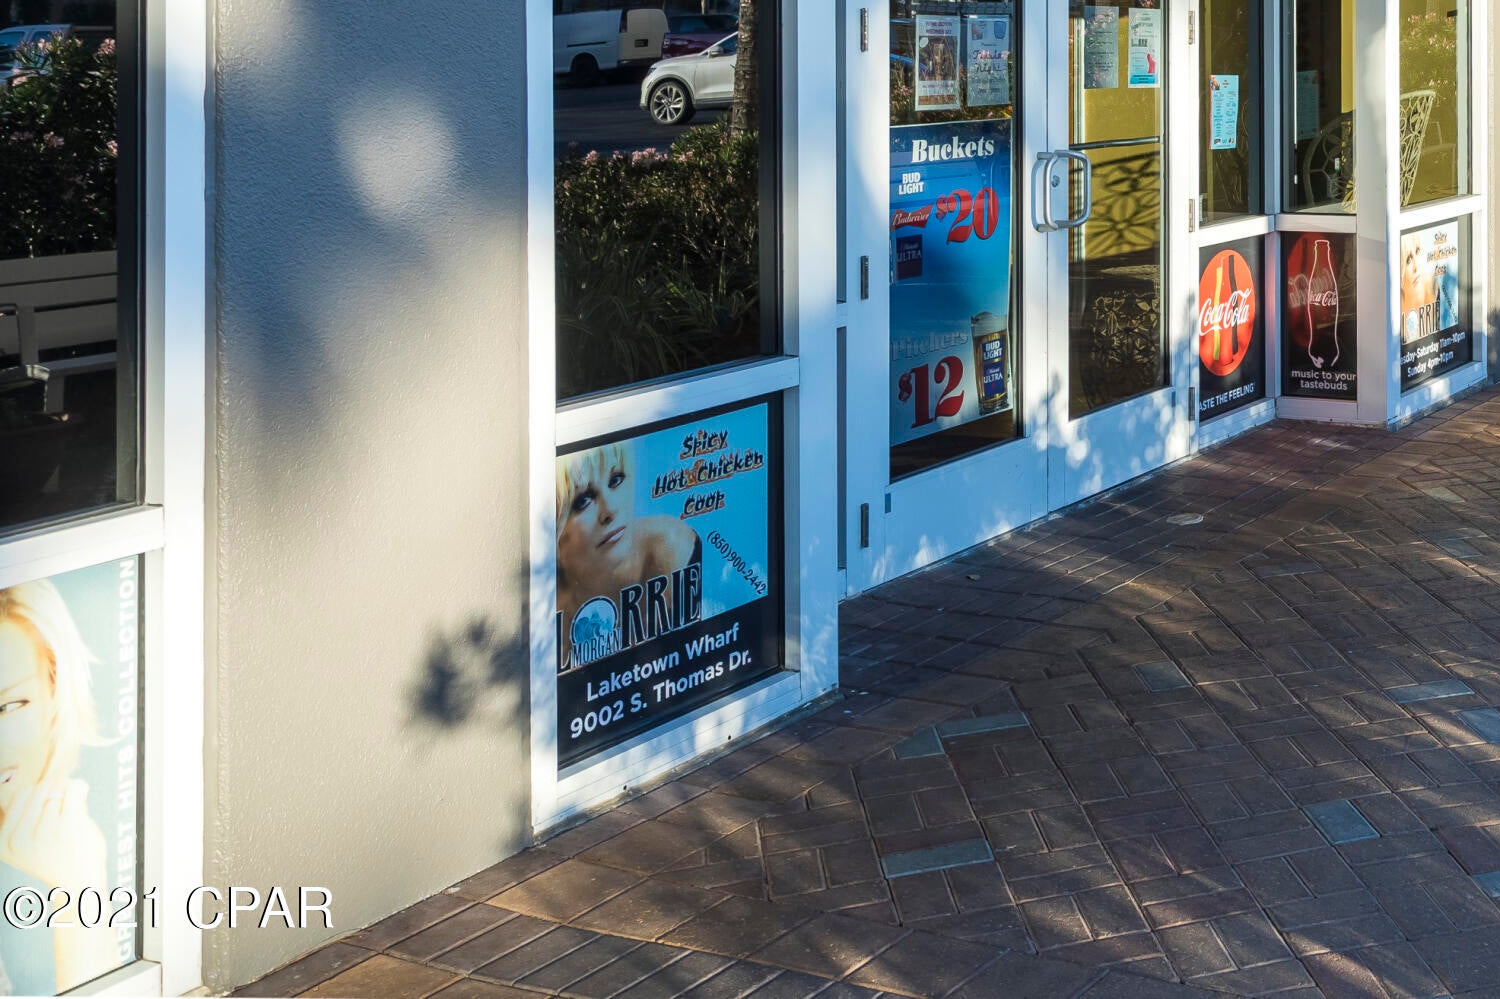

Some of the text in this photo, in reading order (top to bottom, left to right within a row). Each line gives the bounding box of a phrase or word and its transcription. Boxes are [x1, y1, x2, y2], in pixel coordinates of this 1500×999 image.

[911, 136, 995, 163] Buckets
[898, 181, 924, 194] LIGHT
[902, 172, 920, 183] BUD
[892, 212, 930, 226] Budweiser
[936, 186, 999, 245] $20
[983, 347, 1003, 360] LIGHT
[985, 340, 1001, 352] BUD
[983, 372, 1003, 384] ULTRA
[1291, 369, 1356, 382] music to your
[1407, 362, 1427, 378] Sunday
[898, 355, 964, 429] $12
[1216, 392, 1228, 406] THE
[1229, 382, 1254, 401] FEELING
[1301, 380, 1347, 391] tastebuds
[682, 429, 728, 457] Spicy
[653, 450, 764, 496] Hot Chicken
[683, 489, 725, 516] Coop
[706, 530, 767, 595] (850)900-2442
[118, 558, 136, 737] COLLECTION
[571, 627, 622, 669] MORGAN
[586, 622, 739, 702] Laketown Wharf
[570, 649, 752, 738] 9002 S. Thomas Dr.
[118, 744, 134, 809] HITS
